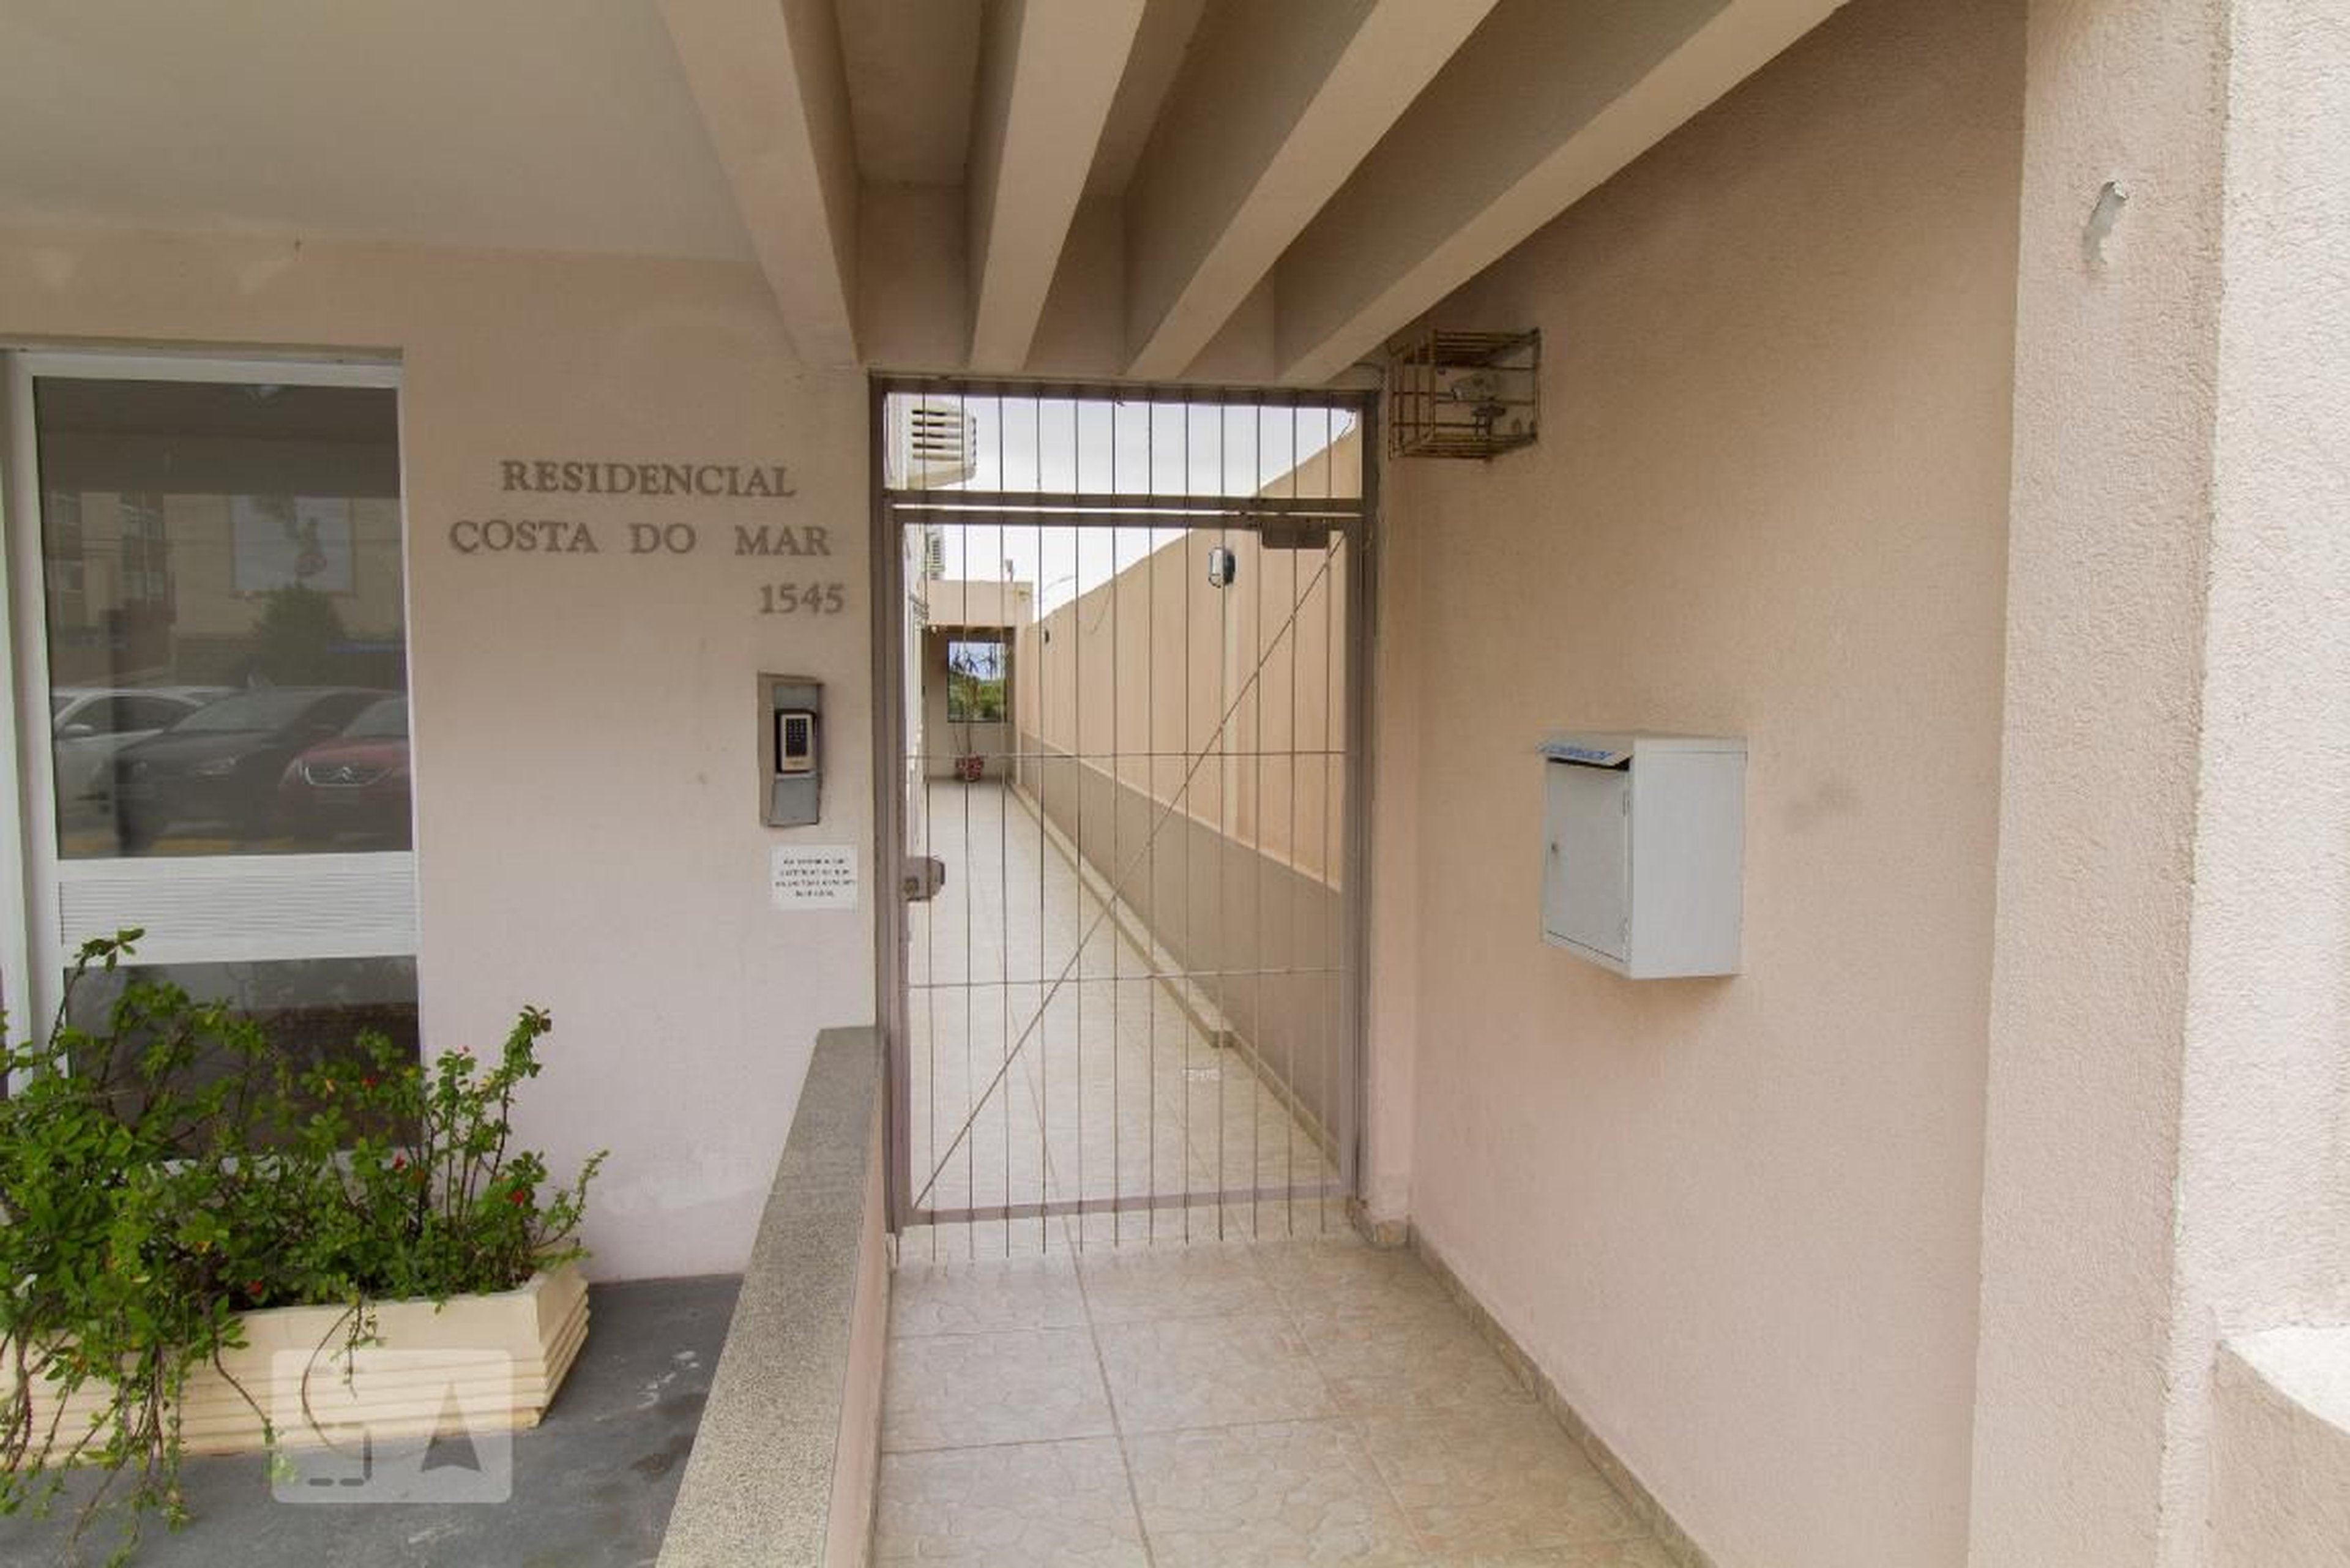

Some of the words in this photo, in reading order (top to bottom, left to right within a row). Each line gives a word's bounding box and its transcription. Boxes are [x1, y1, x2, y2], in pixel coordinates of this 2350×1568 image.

[500, 460, 796, 497] RESIDENCIAL
[449, 520, 599, 553] COSTA
[629, 522, 697, 554] DO
[734, 525, 831, 556] MAR
[758, 582, 844, 616] 1545
